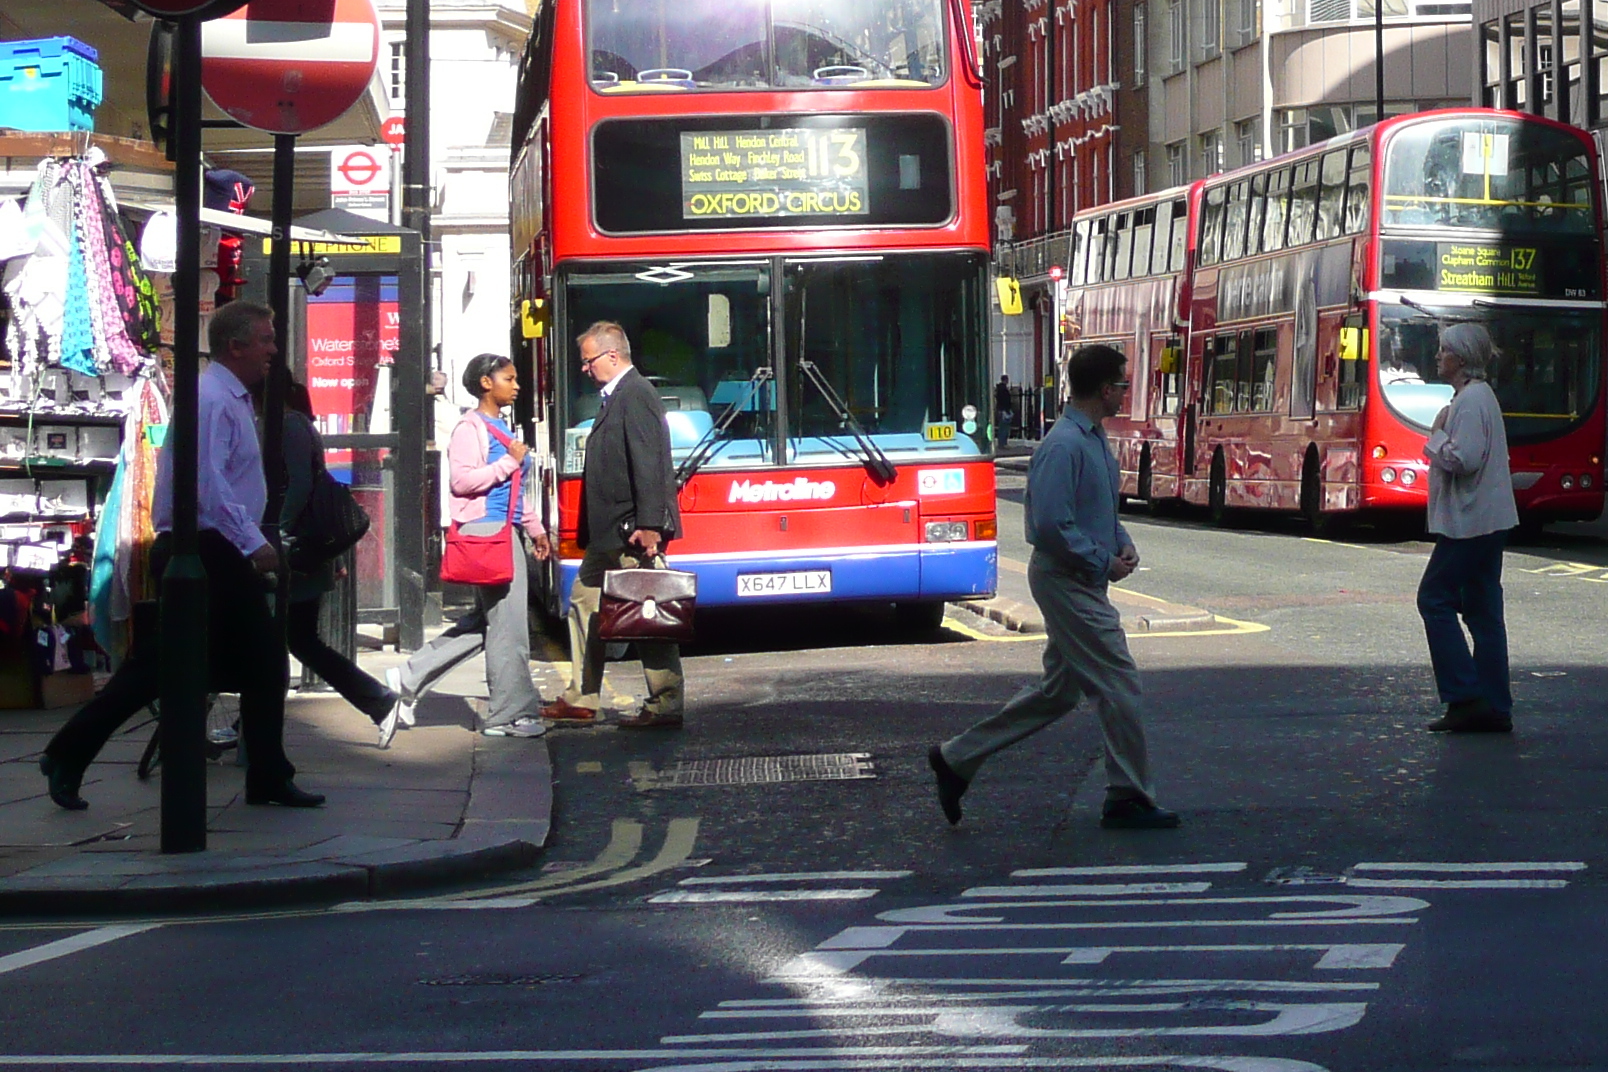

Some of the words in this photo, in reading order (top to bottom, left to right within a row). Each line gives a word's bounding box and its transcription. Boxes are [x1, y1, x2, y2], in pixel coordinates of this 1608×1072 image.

[694, 136, 710, 150] Mill
[714, 135, 729, 149] Hill
[736, 135, 766, 148] Hendon
[769, 134, 799, 148] Central
[690, 153, 720, 166] Hendon
[723, 152, 741, 167] Way
[748, 151, 780, 166] Finchley
[783, 150, 805, 164] Road
[807, 134, 860, 176] 113
[689, 169, 712, 182] Swiss
[716, 169, 747, 183] Cottage
[691, 192, 779, 214] OXFORD
[786, 191, 862, 212] CIRCUS
[1477, 246, 1501, 257] Square
[1511, 248, 1537, 270] 137
[1442, 254, 1475, 267] Clapham
[1476, 254, 1510, 267] Common
[1441, 269, 1494, 286] Streatham
[1498, 272, 1516, 287] Hill
[312, 377, 338, 388] Now
[930, 426, 952, 439] 110
[728, 477, 836, 503] Metroline
[741, 576, 787, 592] X647
[793, 573, 828, 590] LLX
